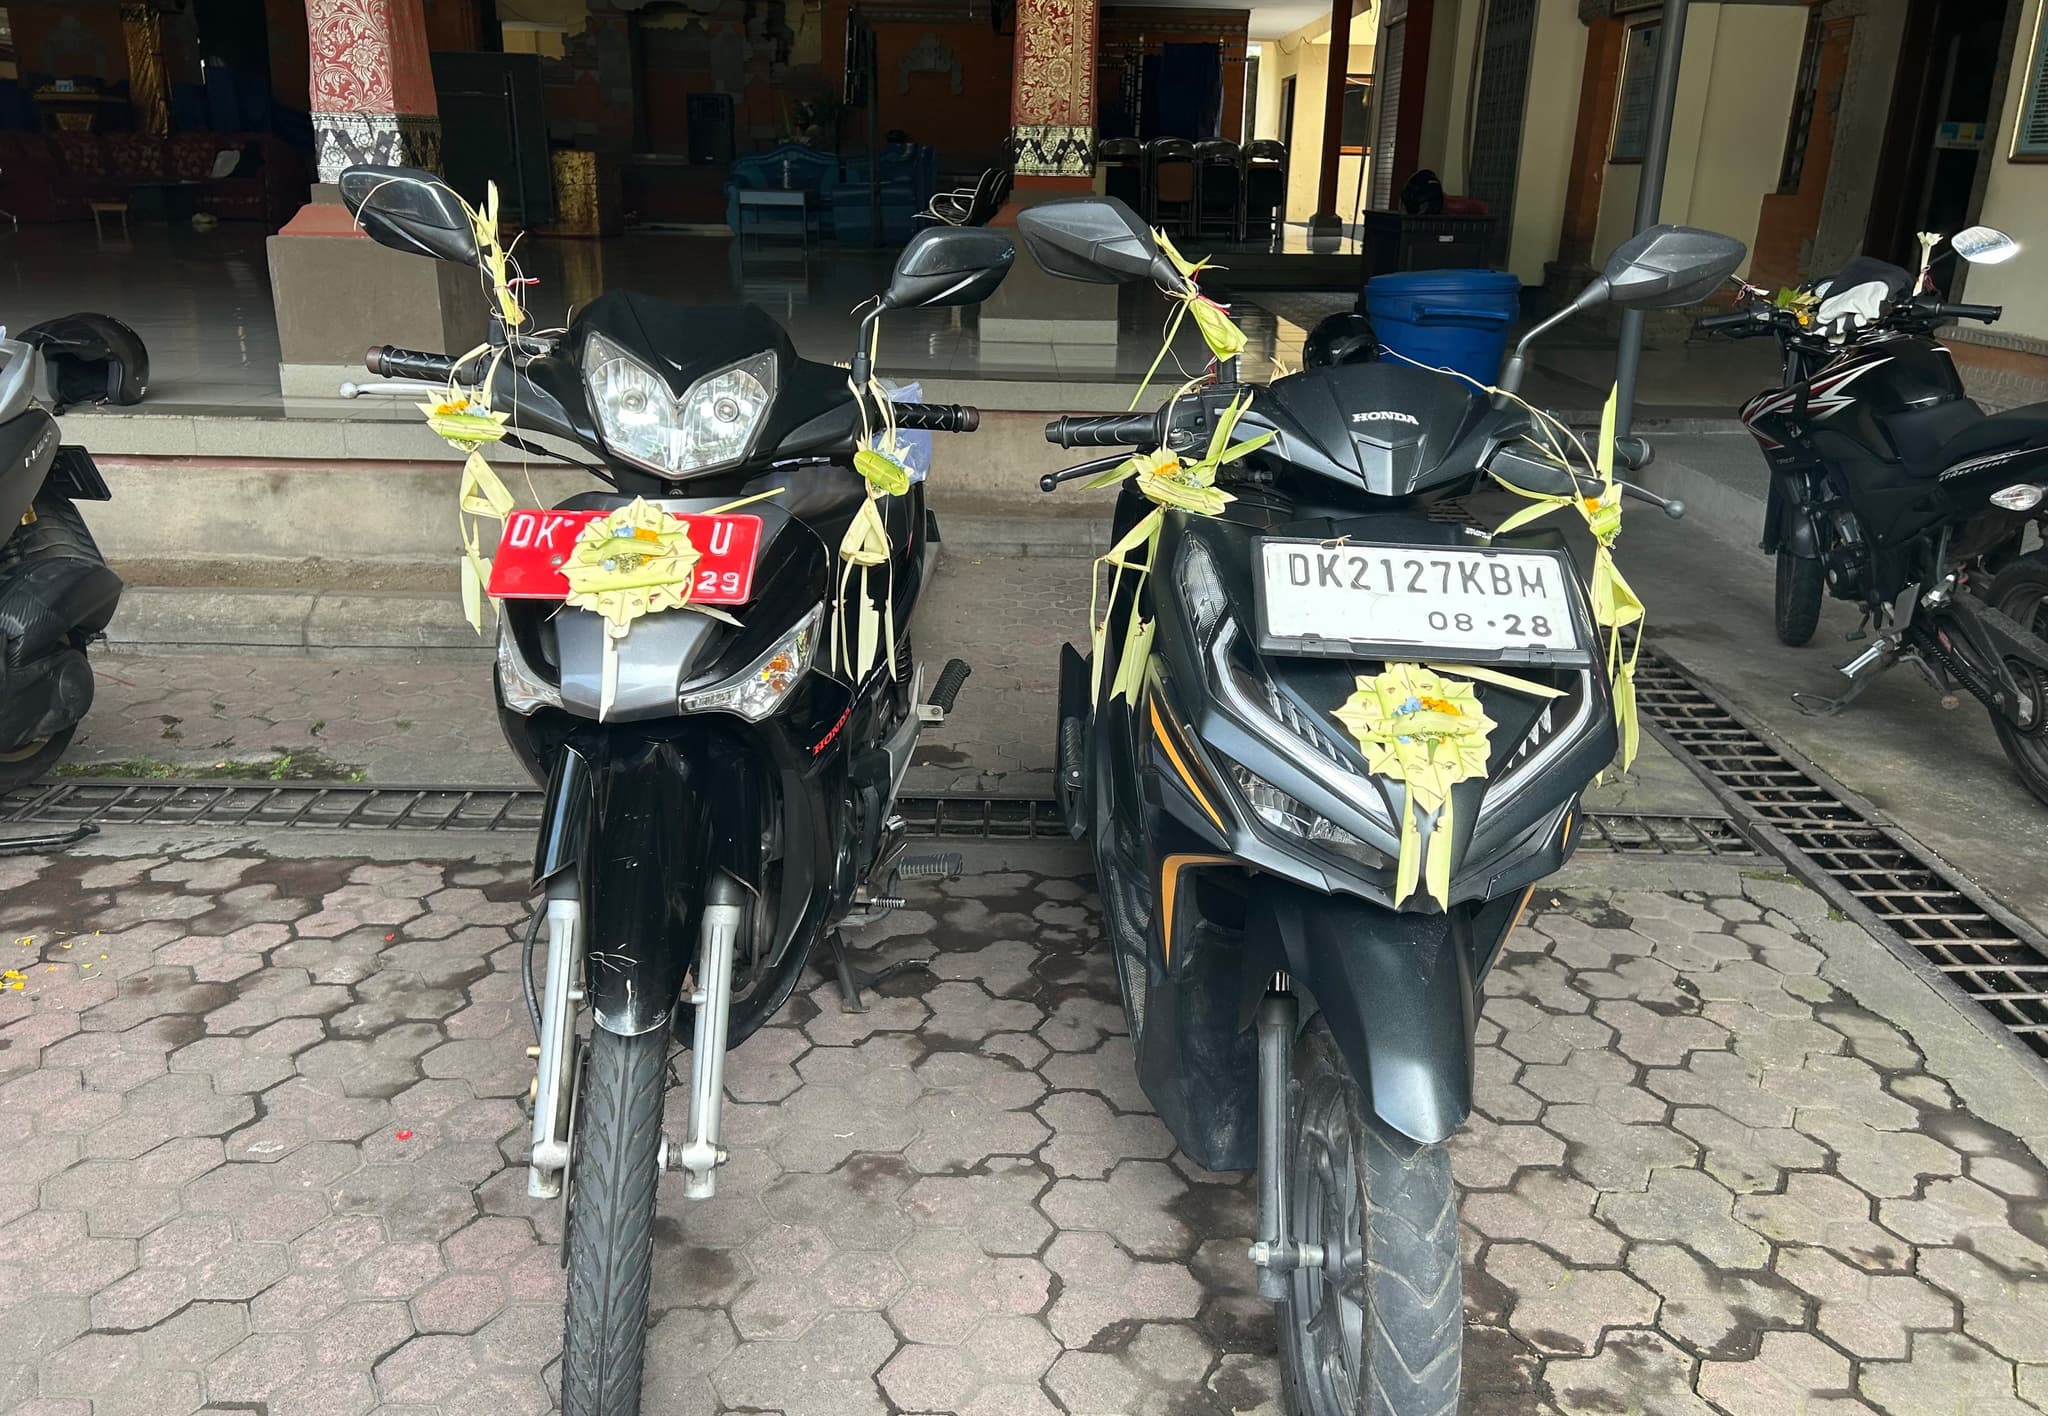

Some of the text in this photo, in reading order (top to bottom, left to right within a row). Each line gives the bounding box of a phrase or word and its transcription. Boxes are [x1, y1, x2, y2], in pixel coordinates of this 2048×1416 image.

[1352, 411, 1419, 425] HONDA
[510, 514, 564, 548] DK
[710, 521, 733, 555] U
[697, 571, 740, 595] 29
[813, 707, 852, 756] HONDA
